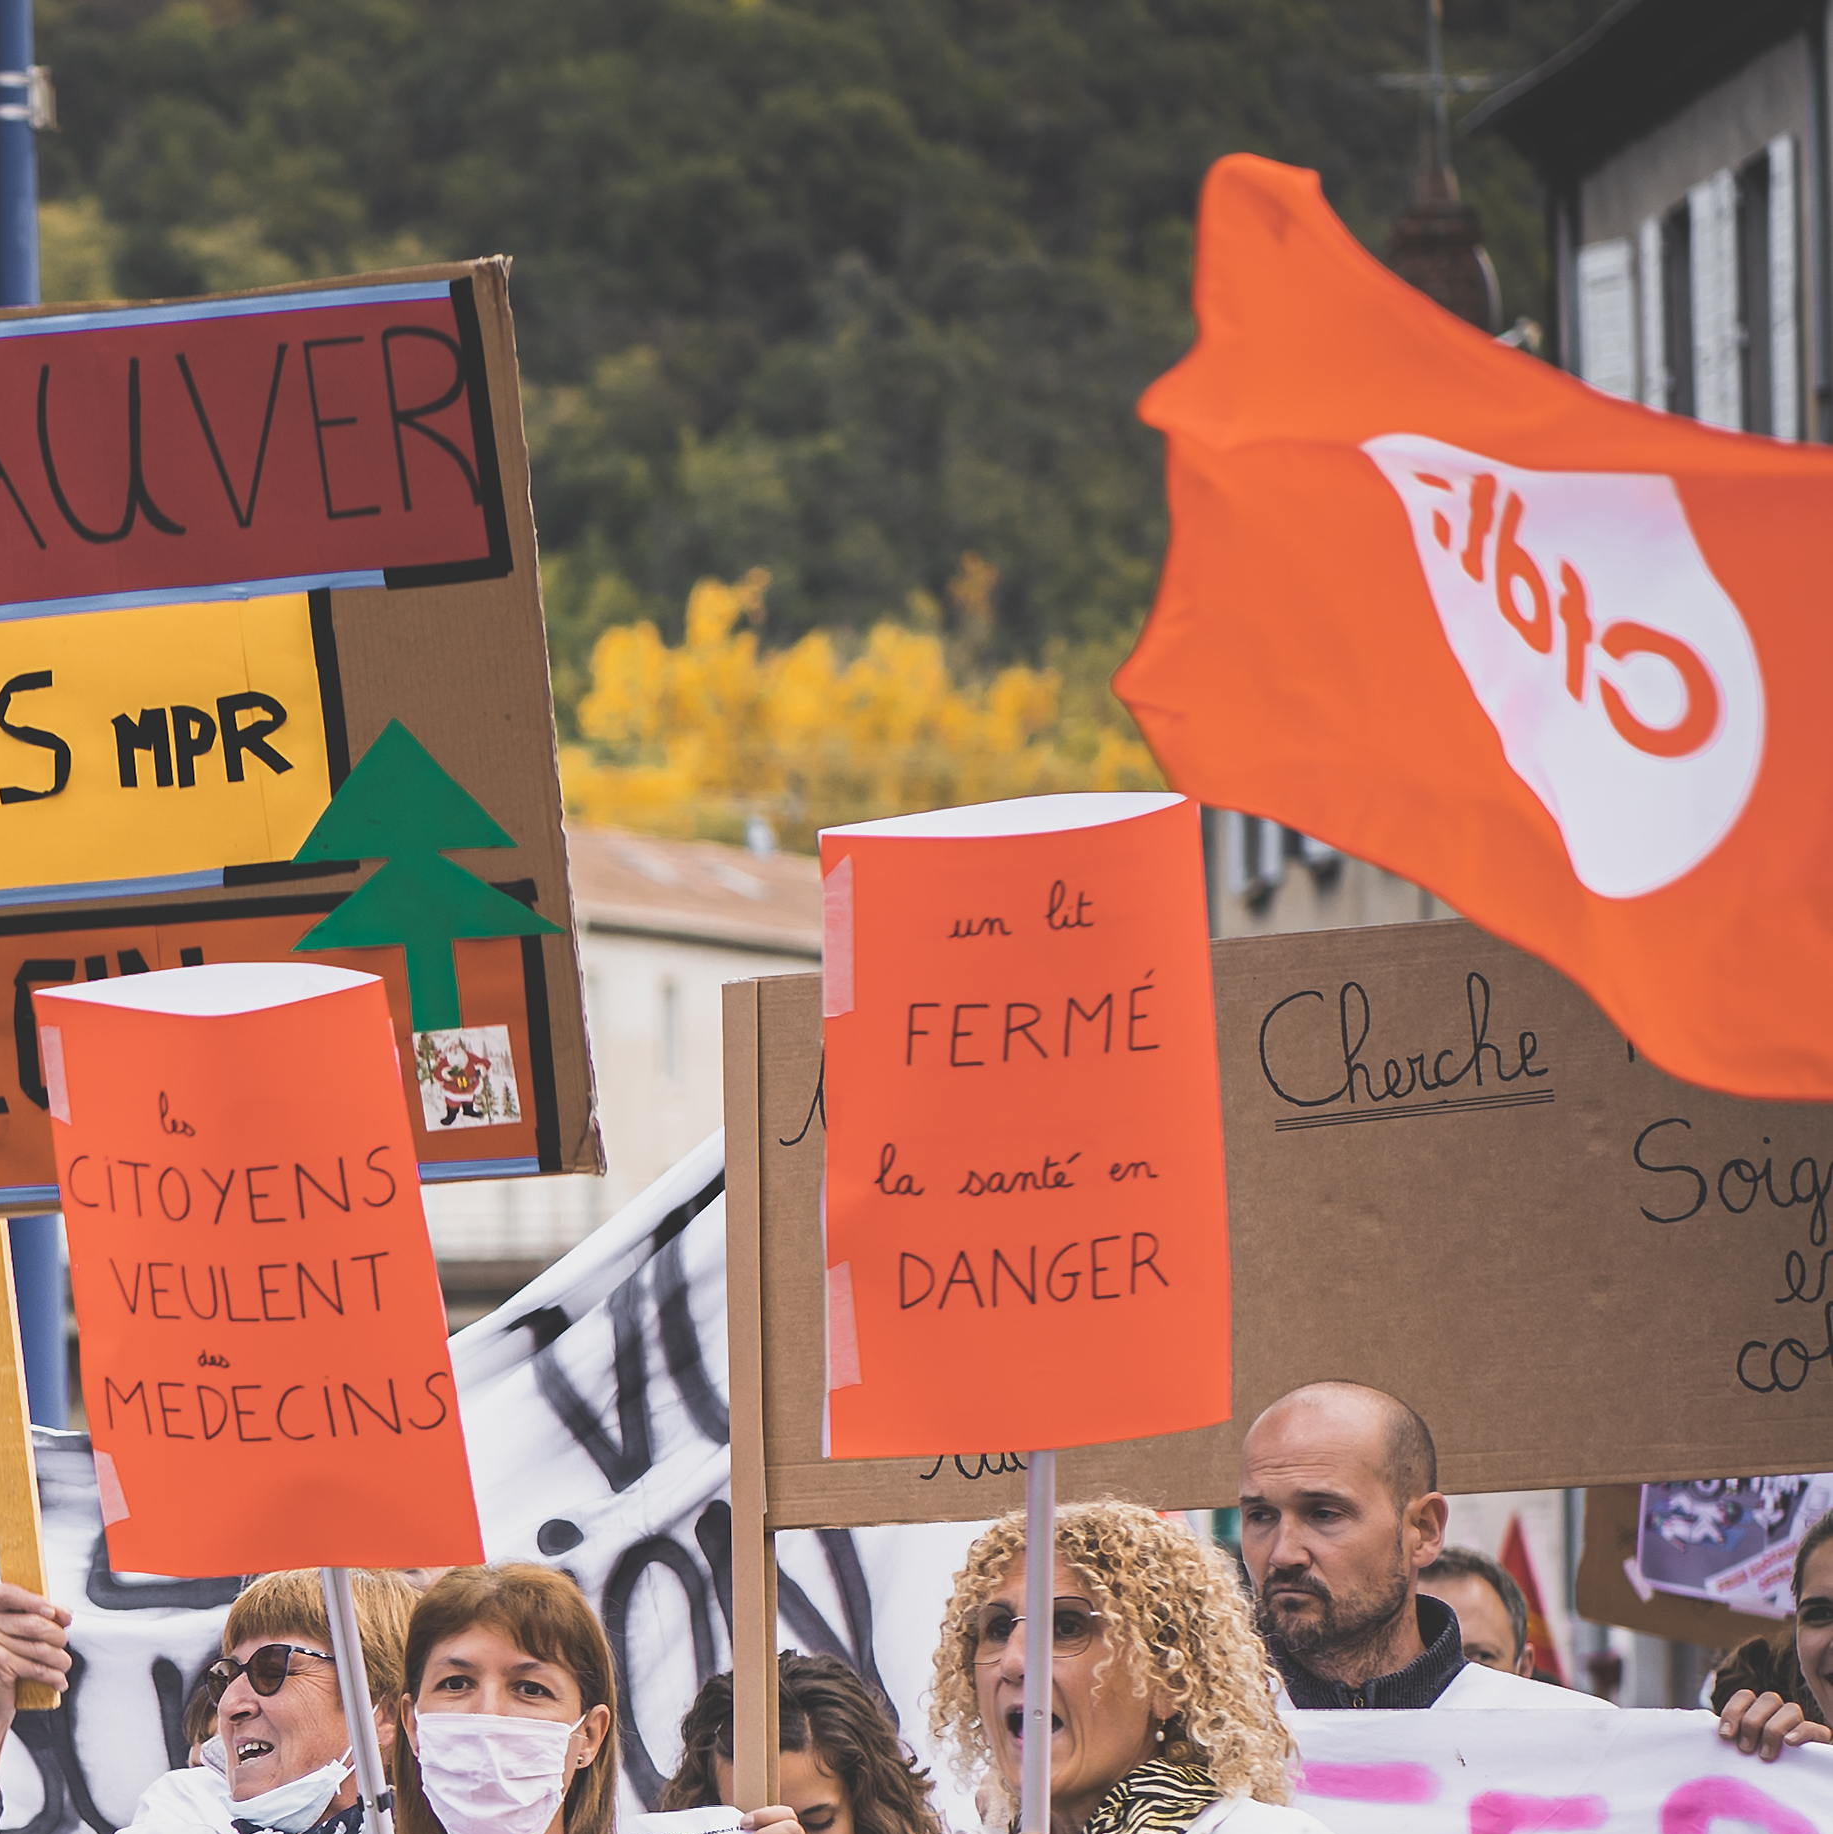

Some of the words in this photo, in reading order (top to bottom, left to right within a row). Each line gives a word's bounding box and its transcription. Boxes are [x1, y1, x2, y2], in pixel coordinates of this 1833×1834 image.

[111, 690, 294, 789] MPR
[947, 914, 1012, 938] un
[1045, 879, 1095, 931] lit
[907, 969, 1161, 1068] FERMÉ
[1259, 972, 1548, 1107] Cherche
[159, 1091, 196, 1138] les
[874, 1143, 924, 1197] la
[957, 1151, 1084, 1197] santé
[1109, 1156, 1159, 1183] en
[109, 1251, 390, 1323] VEULENT
[899, 1231, 1170, 1310] DANGER
[198, 1348, 231, 1370] des
